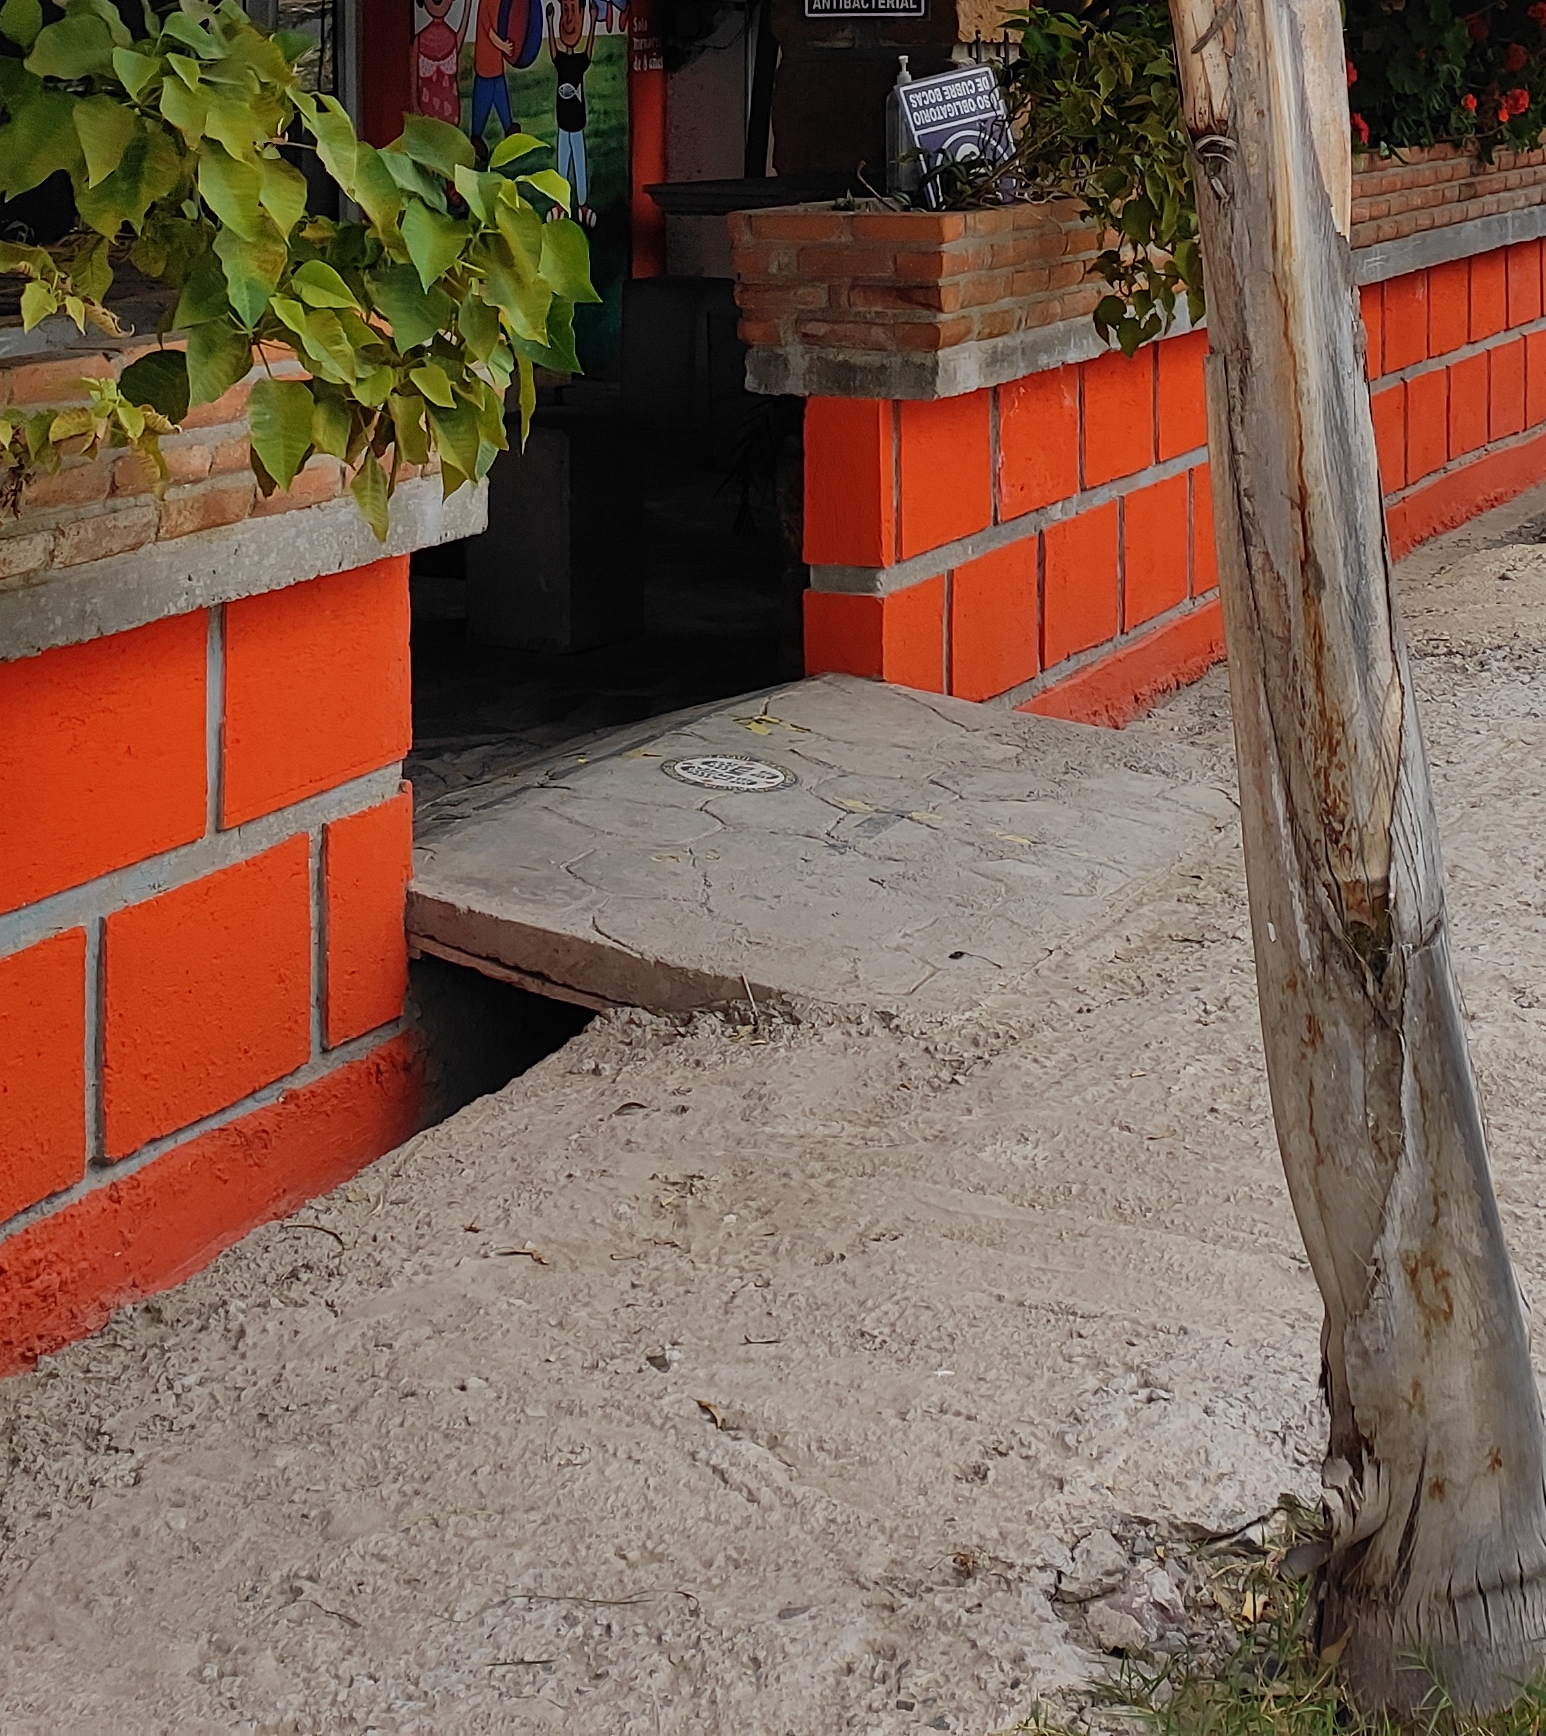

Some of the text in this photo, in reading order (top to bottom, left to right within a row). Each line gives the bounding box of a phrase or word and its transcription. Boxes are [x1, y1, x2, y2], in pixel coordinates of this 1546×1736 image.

[909, 76, 991, 108] DE CUBRE BOCAS
[914, 96, 977, 125] OBLIGATORIO
